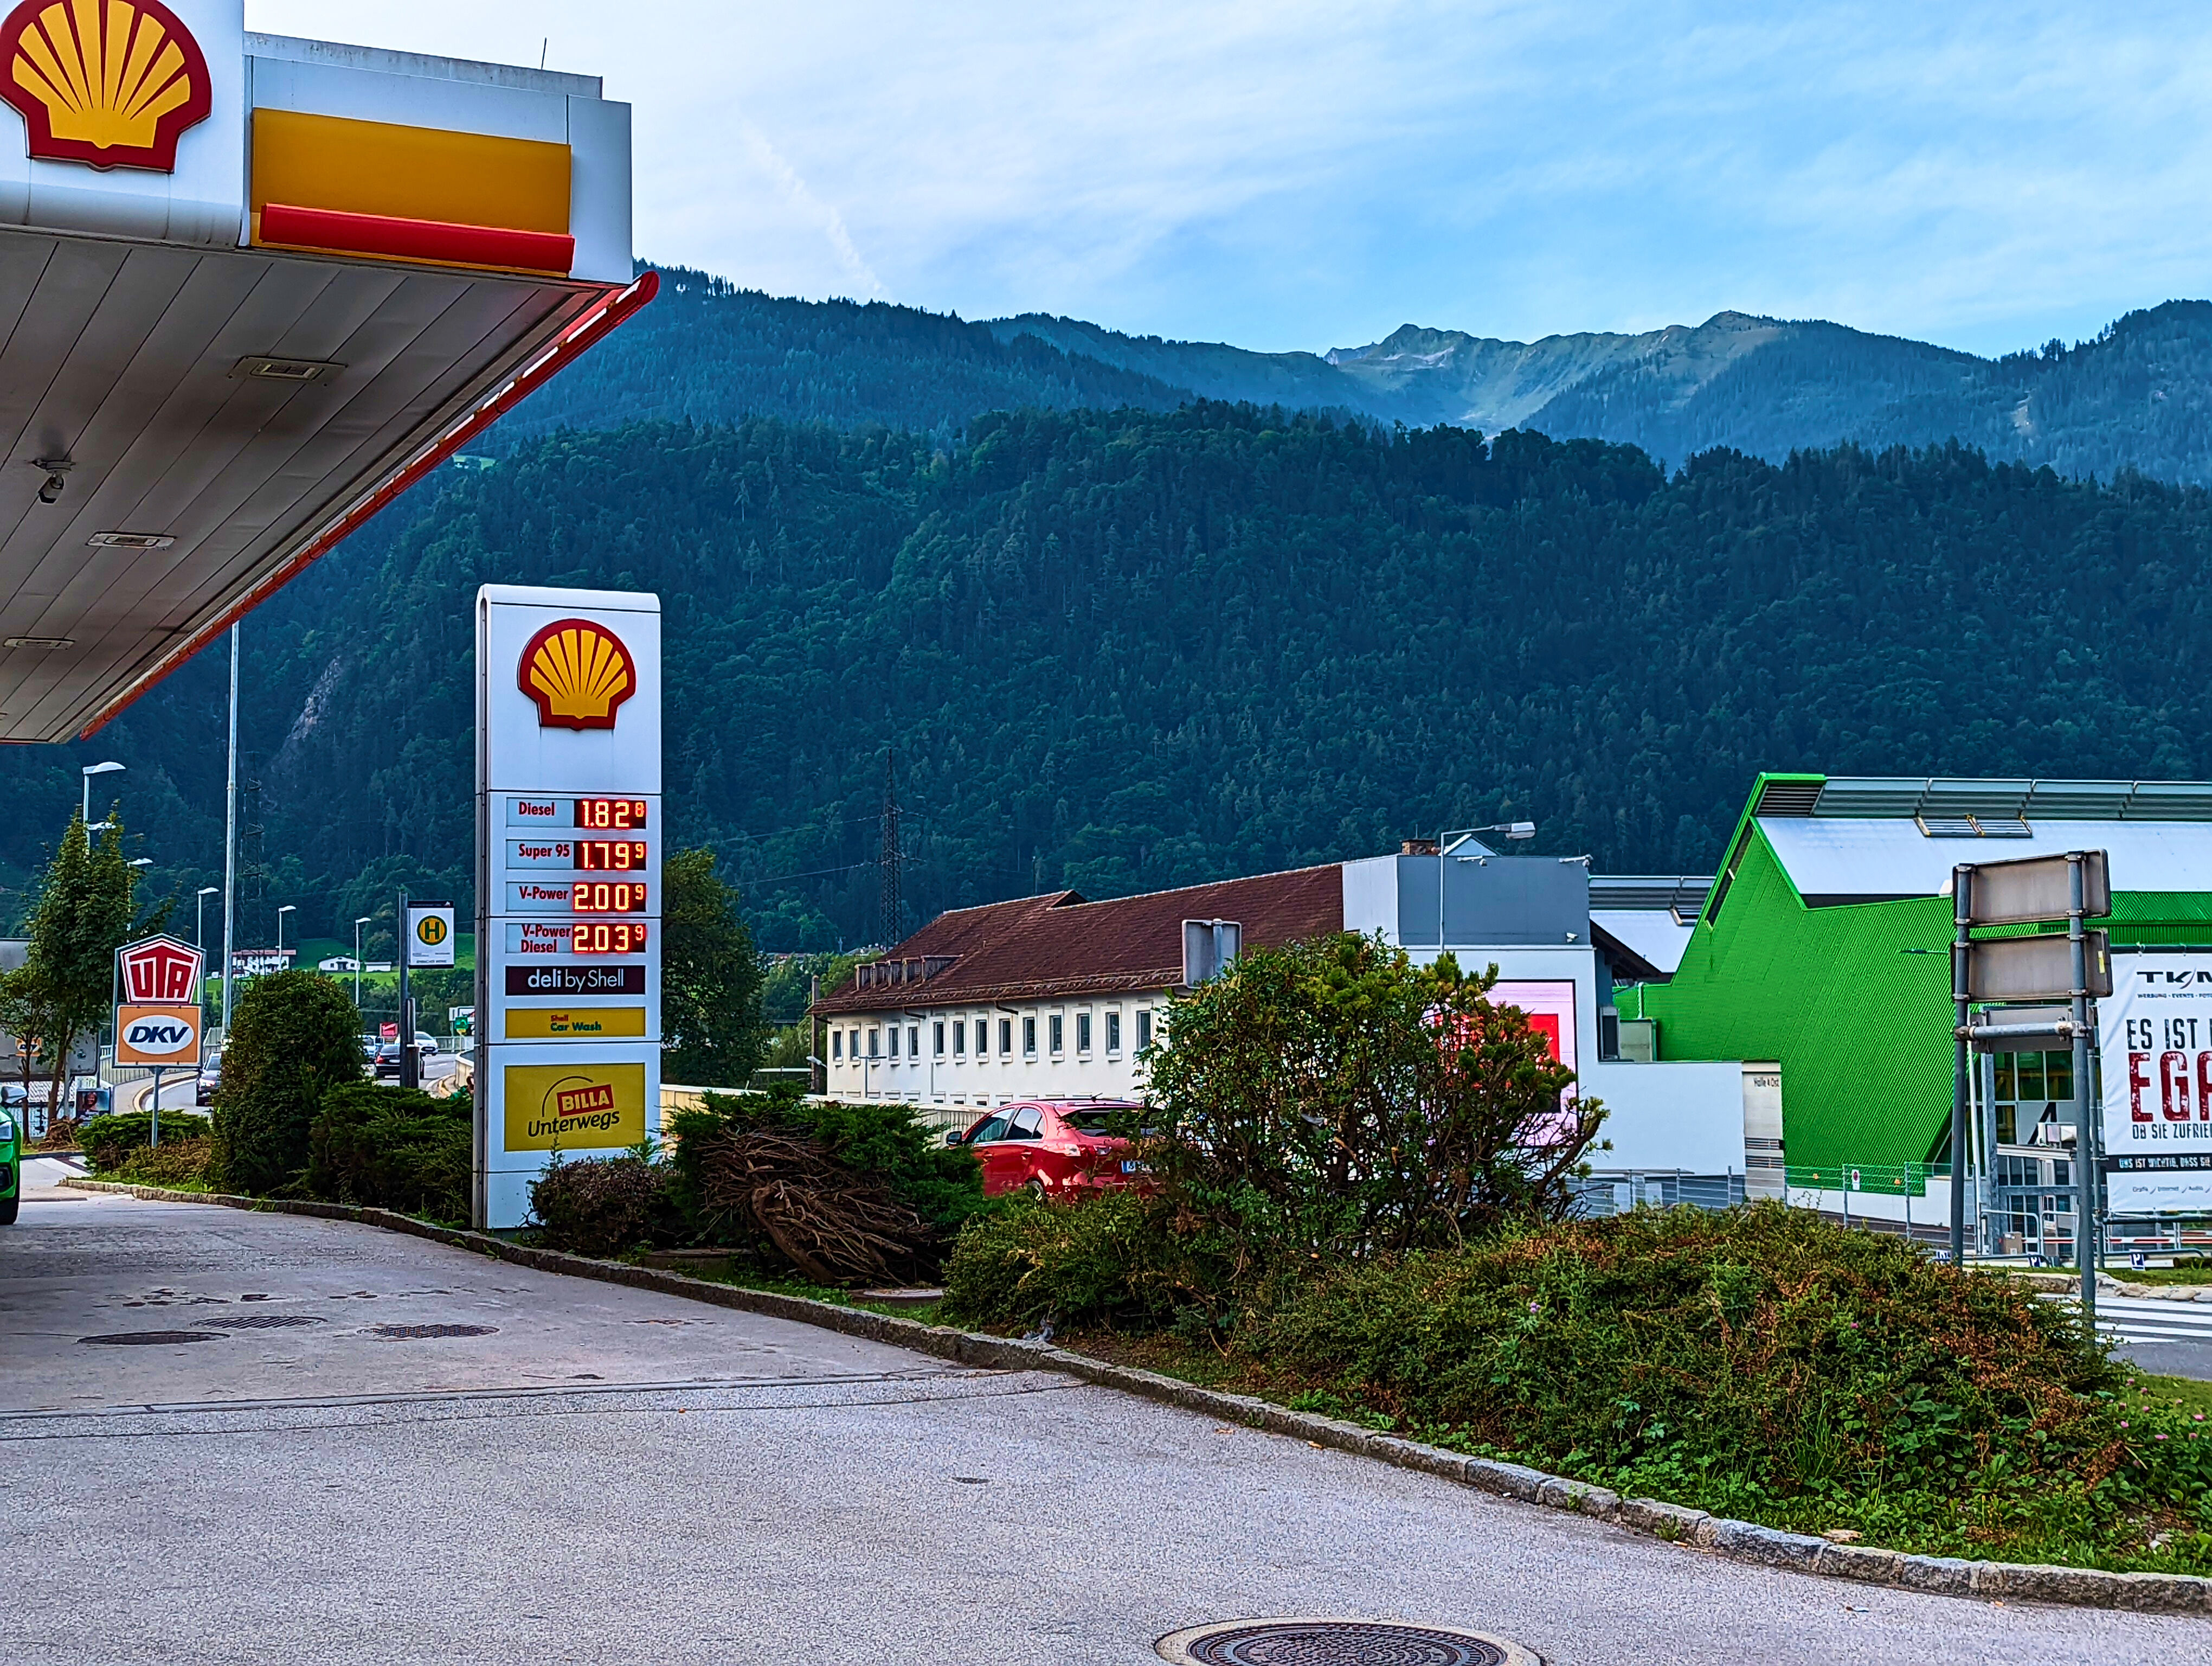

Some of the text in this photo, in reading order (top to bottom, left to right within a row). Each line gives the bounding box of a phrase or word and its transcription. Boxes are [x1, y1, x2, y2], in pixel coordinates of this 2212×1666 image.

[519, 802, 555, 816] Diesel
[519, 844, 570, 860] Super 95
[519, 886, 569, 900] V-Power
[425, 921, 440, 939] H
[522, 924, 571, 938] V-Power
[521, 940, 557, 953] Diesel
[128, 945, 194, 998] UTA
[551, 1021, 602, 1031] Car Wash
[2126, 1018, 2152, 1050] ES
[2164, 1018, 2198, 1049] IST
[128, 1026, 189, 1043] DKV
[561, 1089, 610, 1112] BILLA
[528, 1110, 620, 1137] Unterwegs
[2132, 1124, 2146, 1139] OB
[2152, 1124, 2168, 1139] SIE
